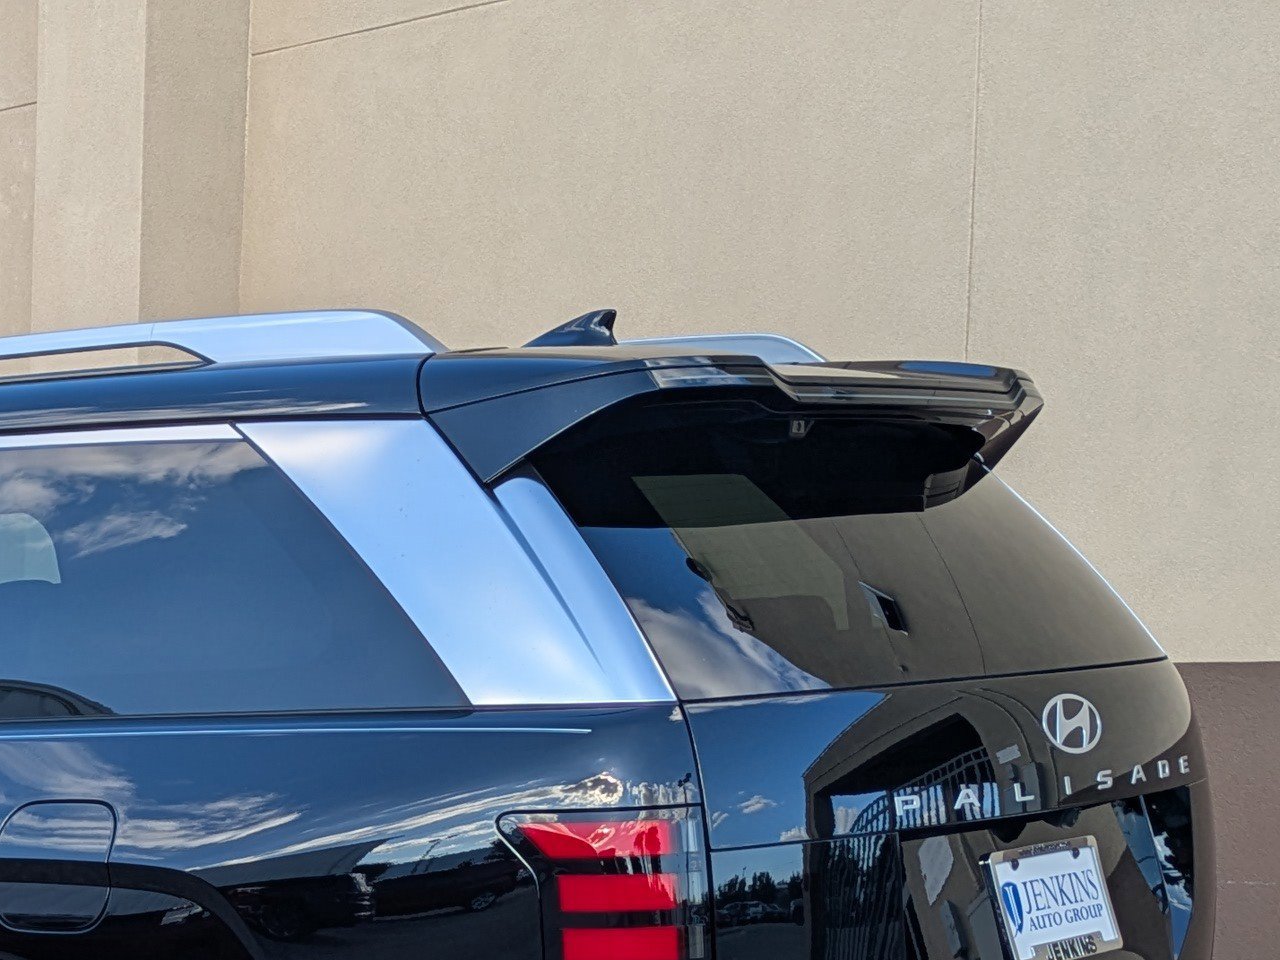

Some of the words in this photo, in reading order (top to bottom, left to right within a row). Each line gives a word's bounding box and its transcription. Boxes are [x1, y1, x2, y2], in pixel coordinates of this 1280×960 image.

[894, 755, 1191, 817] PALISADE
[1021, 868, 1099, 914] JENKINS
[1029, 912, 1063, 931] AUTO
[1064, 903, 1103, 924] GROUP
